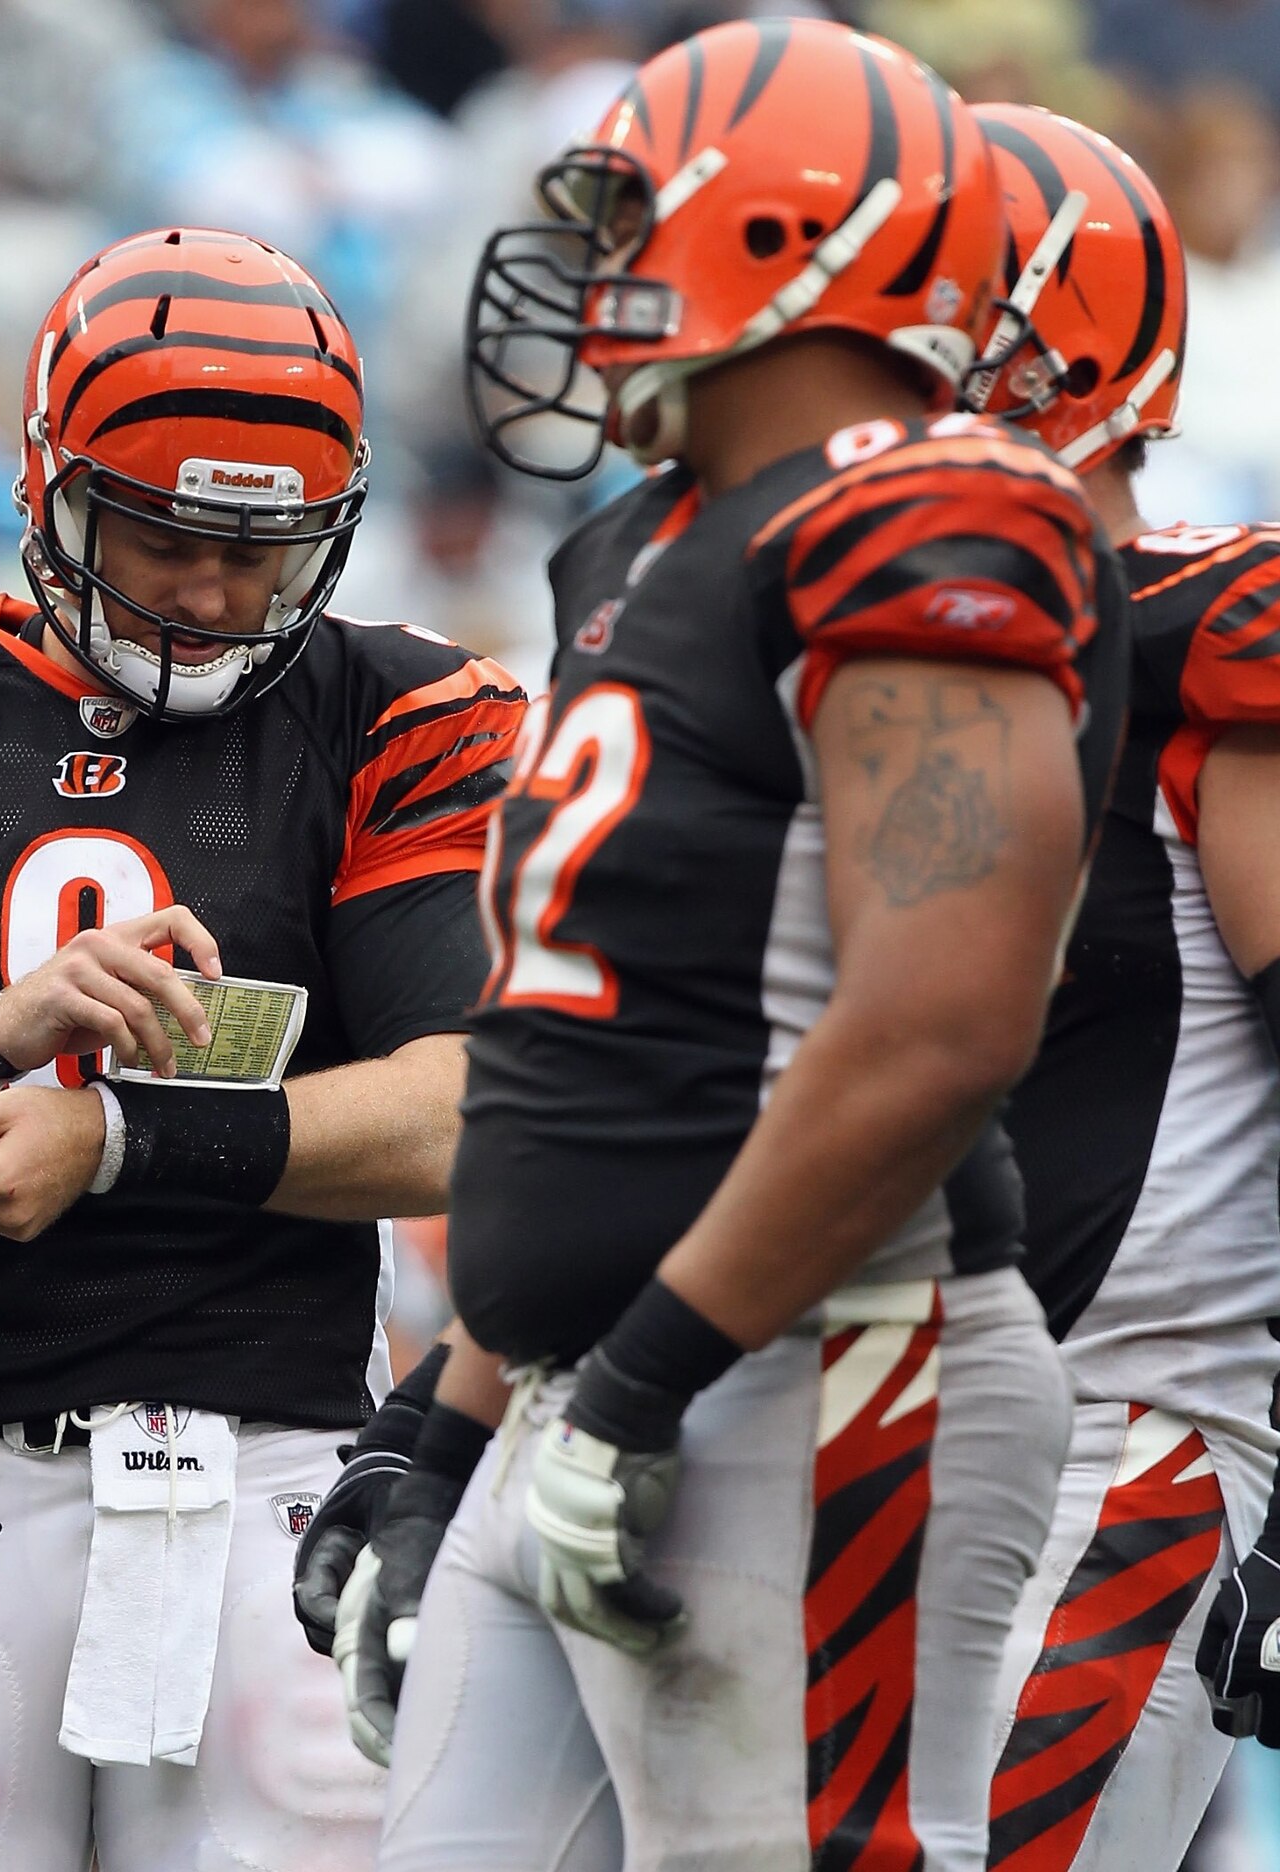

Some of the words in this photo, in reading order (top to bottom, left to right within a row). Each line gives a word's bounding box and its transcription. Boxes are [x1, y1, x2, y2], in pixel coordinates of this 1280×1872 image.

[211, 469, 275, 489] Riddell
[472, 679, 654, 1020] 2
[273, 1494, 320, 1507] EQUIPMENT
